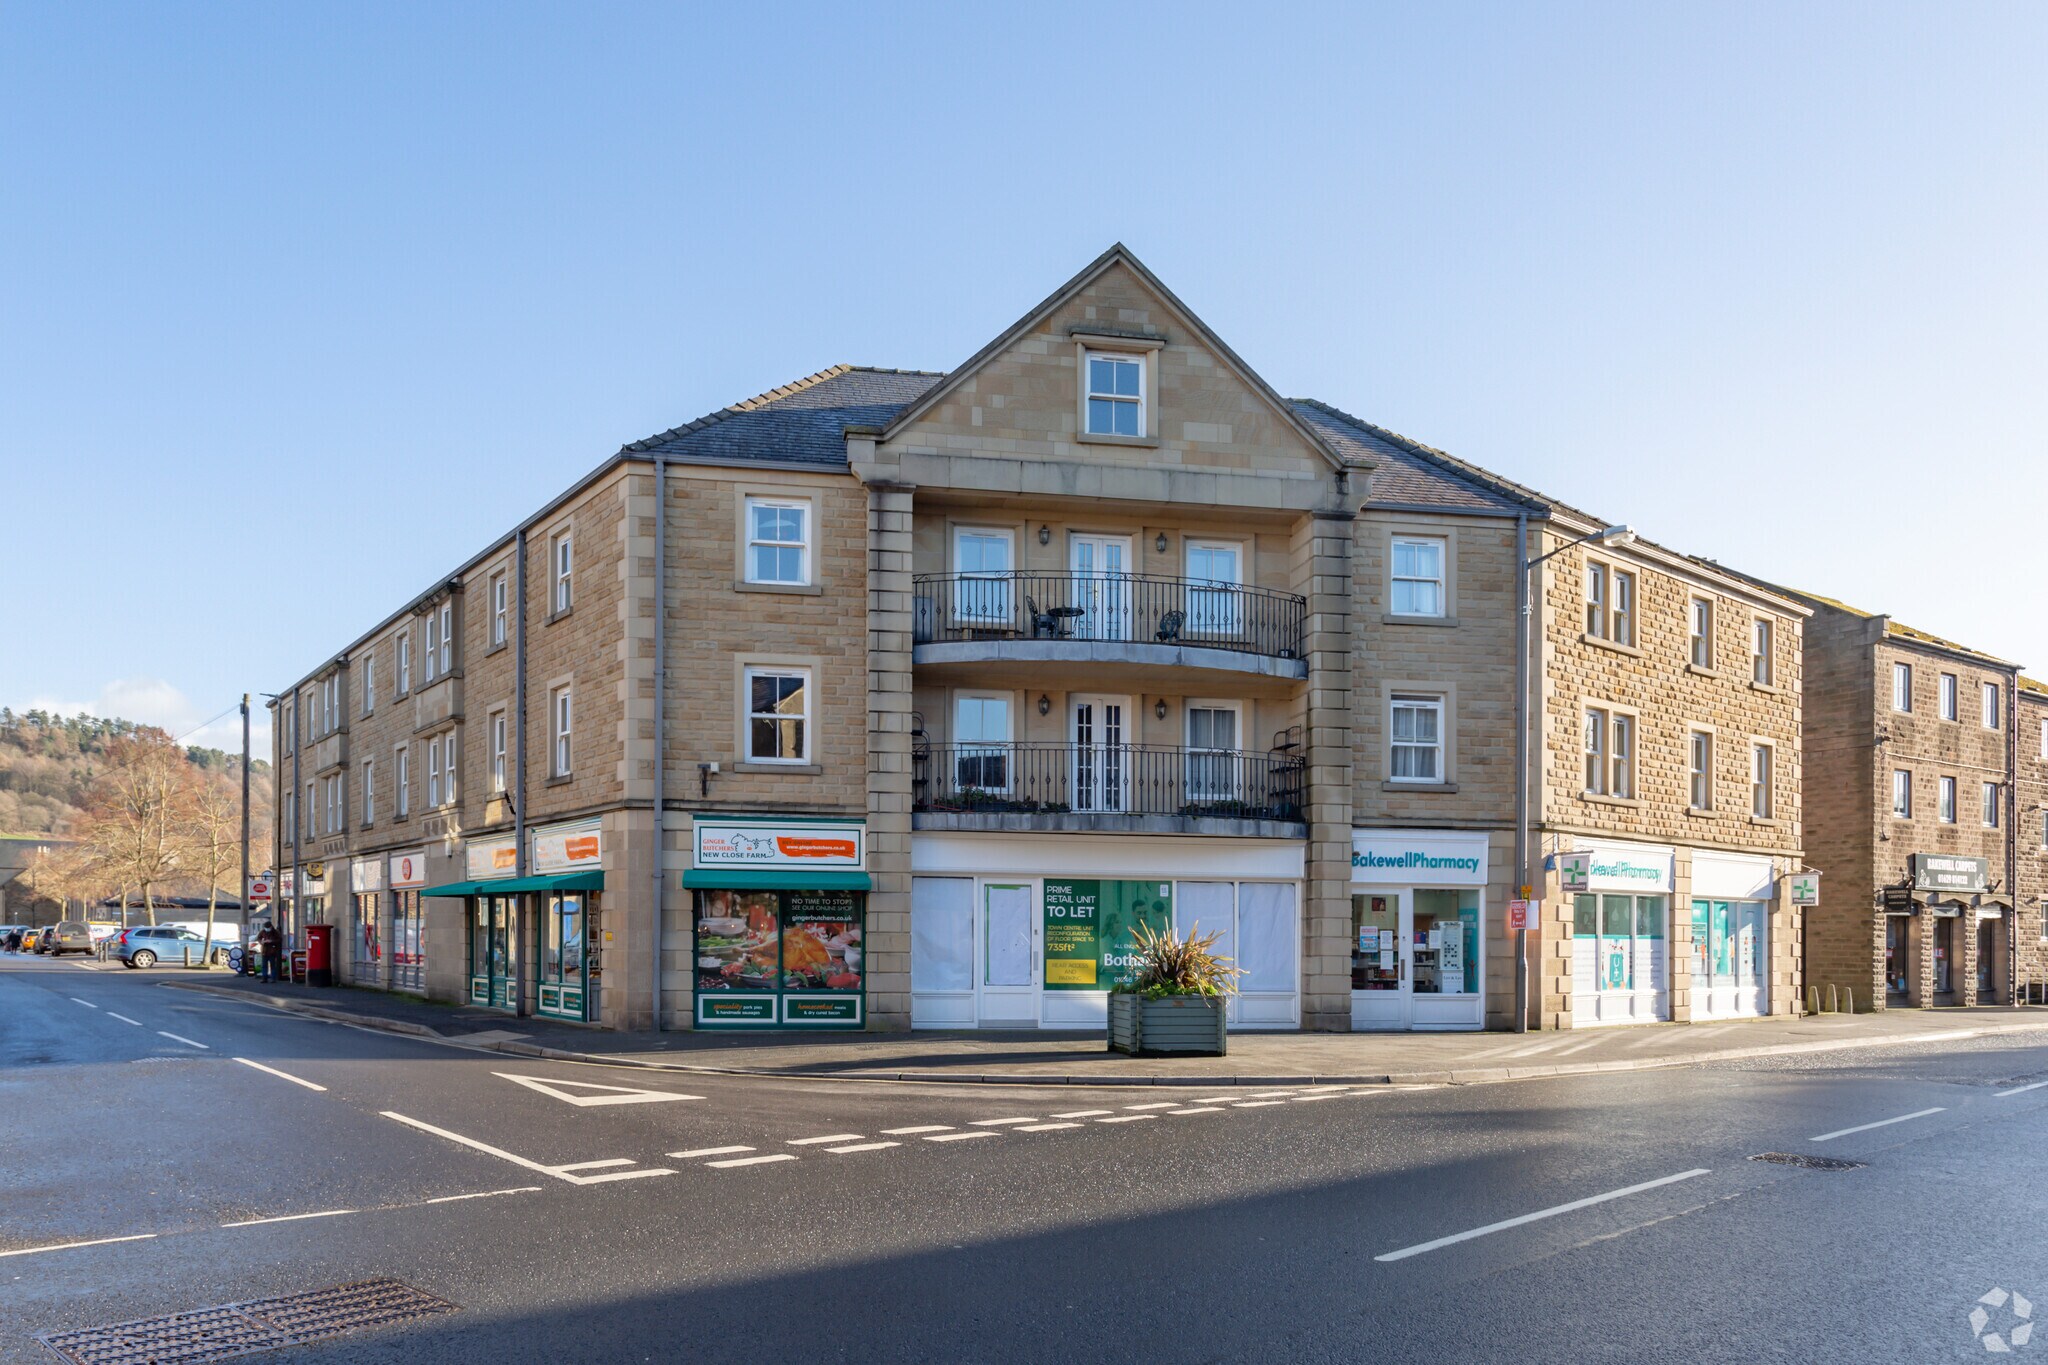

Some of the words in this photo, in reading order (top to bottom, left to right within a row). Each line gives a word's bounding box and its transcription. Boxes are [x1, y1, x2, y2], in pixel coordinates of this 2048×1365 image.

[1955, 860, 1977, 873] CARPETS
[1046, 886, 1072, 894] PRIME
[1046, 895, 1074, 904] RETAIL
[1076, 895, 1096, 904] UNIT
[1047, 905, 1067, 918] TO
[1070, 906, 1095, 918] LET
[1104, 953, 1150, 967] Botha
